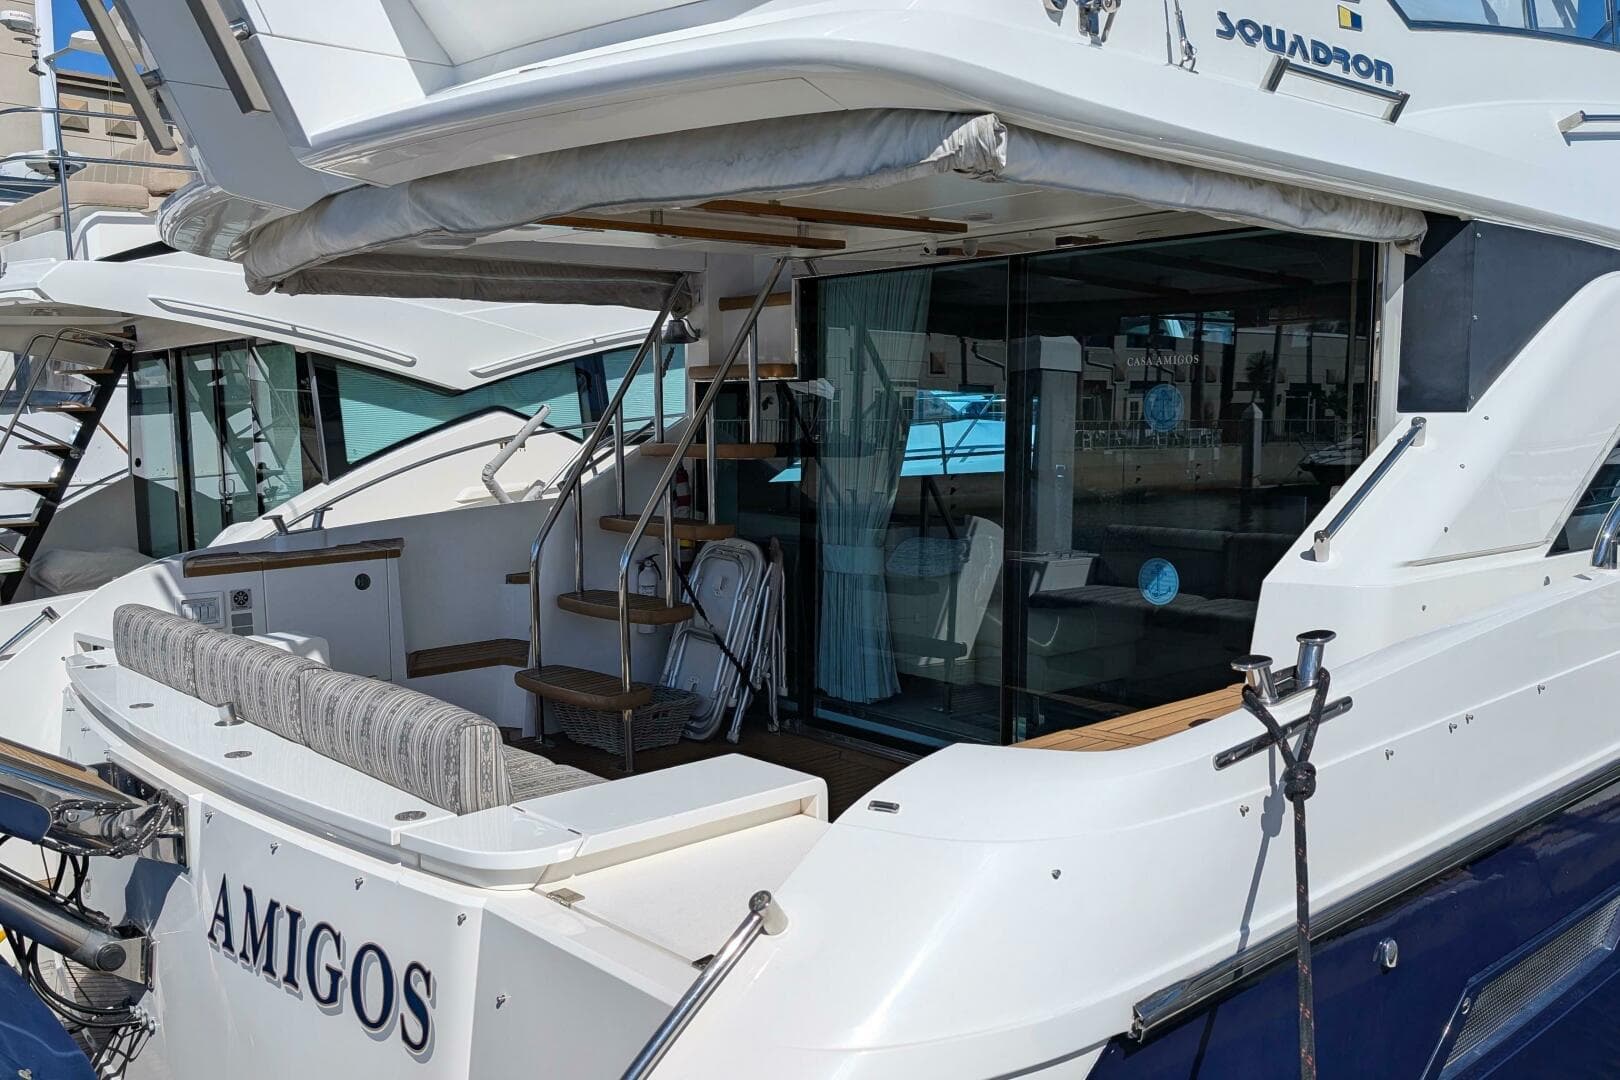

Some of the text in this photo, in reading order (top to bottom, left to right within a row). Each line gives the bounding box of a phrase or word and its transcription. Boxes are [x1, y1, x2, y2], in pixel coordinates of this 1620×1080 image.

[1215, 11, 1394, 86] SQUADRON
[1127, 354, 1200, 367] CASA AMIGOS
[207, 873, 436, 1062] AMIGOS
